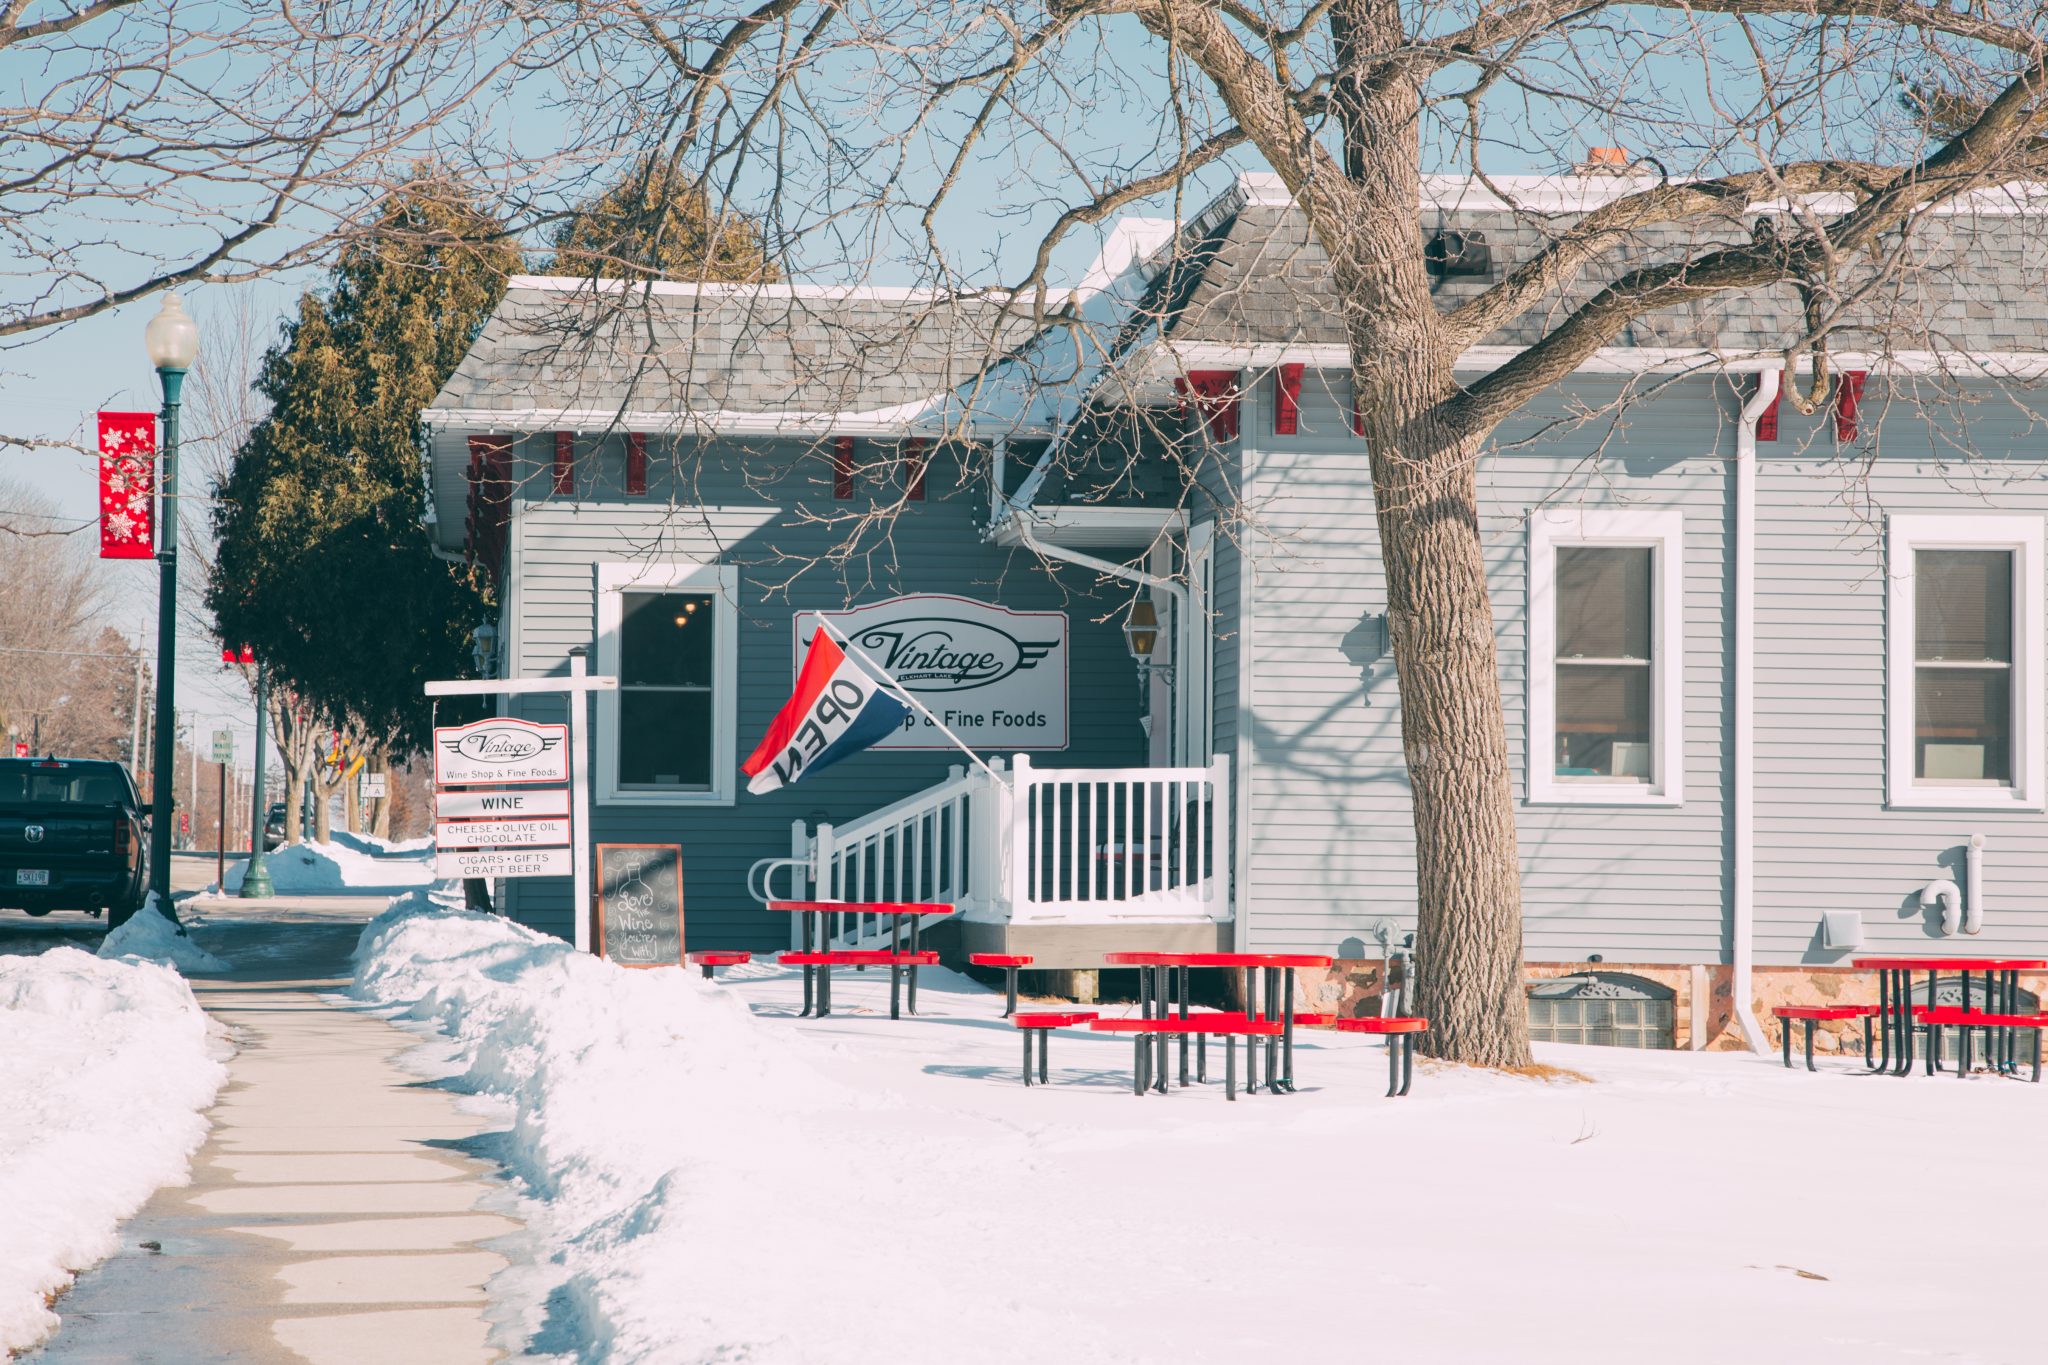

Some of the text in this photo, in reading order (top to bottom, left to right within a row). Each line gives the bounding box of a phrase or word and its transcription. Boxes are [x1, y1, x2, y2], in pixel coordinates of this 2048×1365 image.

[861, 630, 1004, 685] Vintage
[900, 673, 932, 681] ELKHART
[945, 710, 985, 727] Fine
[992, 710, 1047, 727] Foods
[468, 733, 536, 759] Vintage
[447, 768, 557, 780] Wine Shop & Fine Foods
[481, 797, 524, 810] WINE
[447, 822, 558, 834] CHEESE OLIVE OIL
[467, 834, 537, 844] CHOCOLATE
[458, 853, 549, 865] CIGARS GIFTS
[464, 864, 541, 875] CRAFT BEER
[617, 891, 654, 912] Love
[618, 913, 654, 932] Wine
